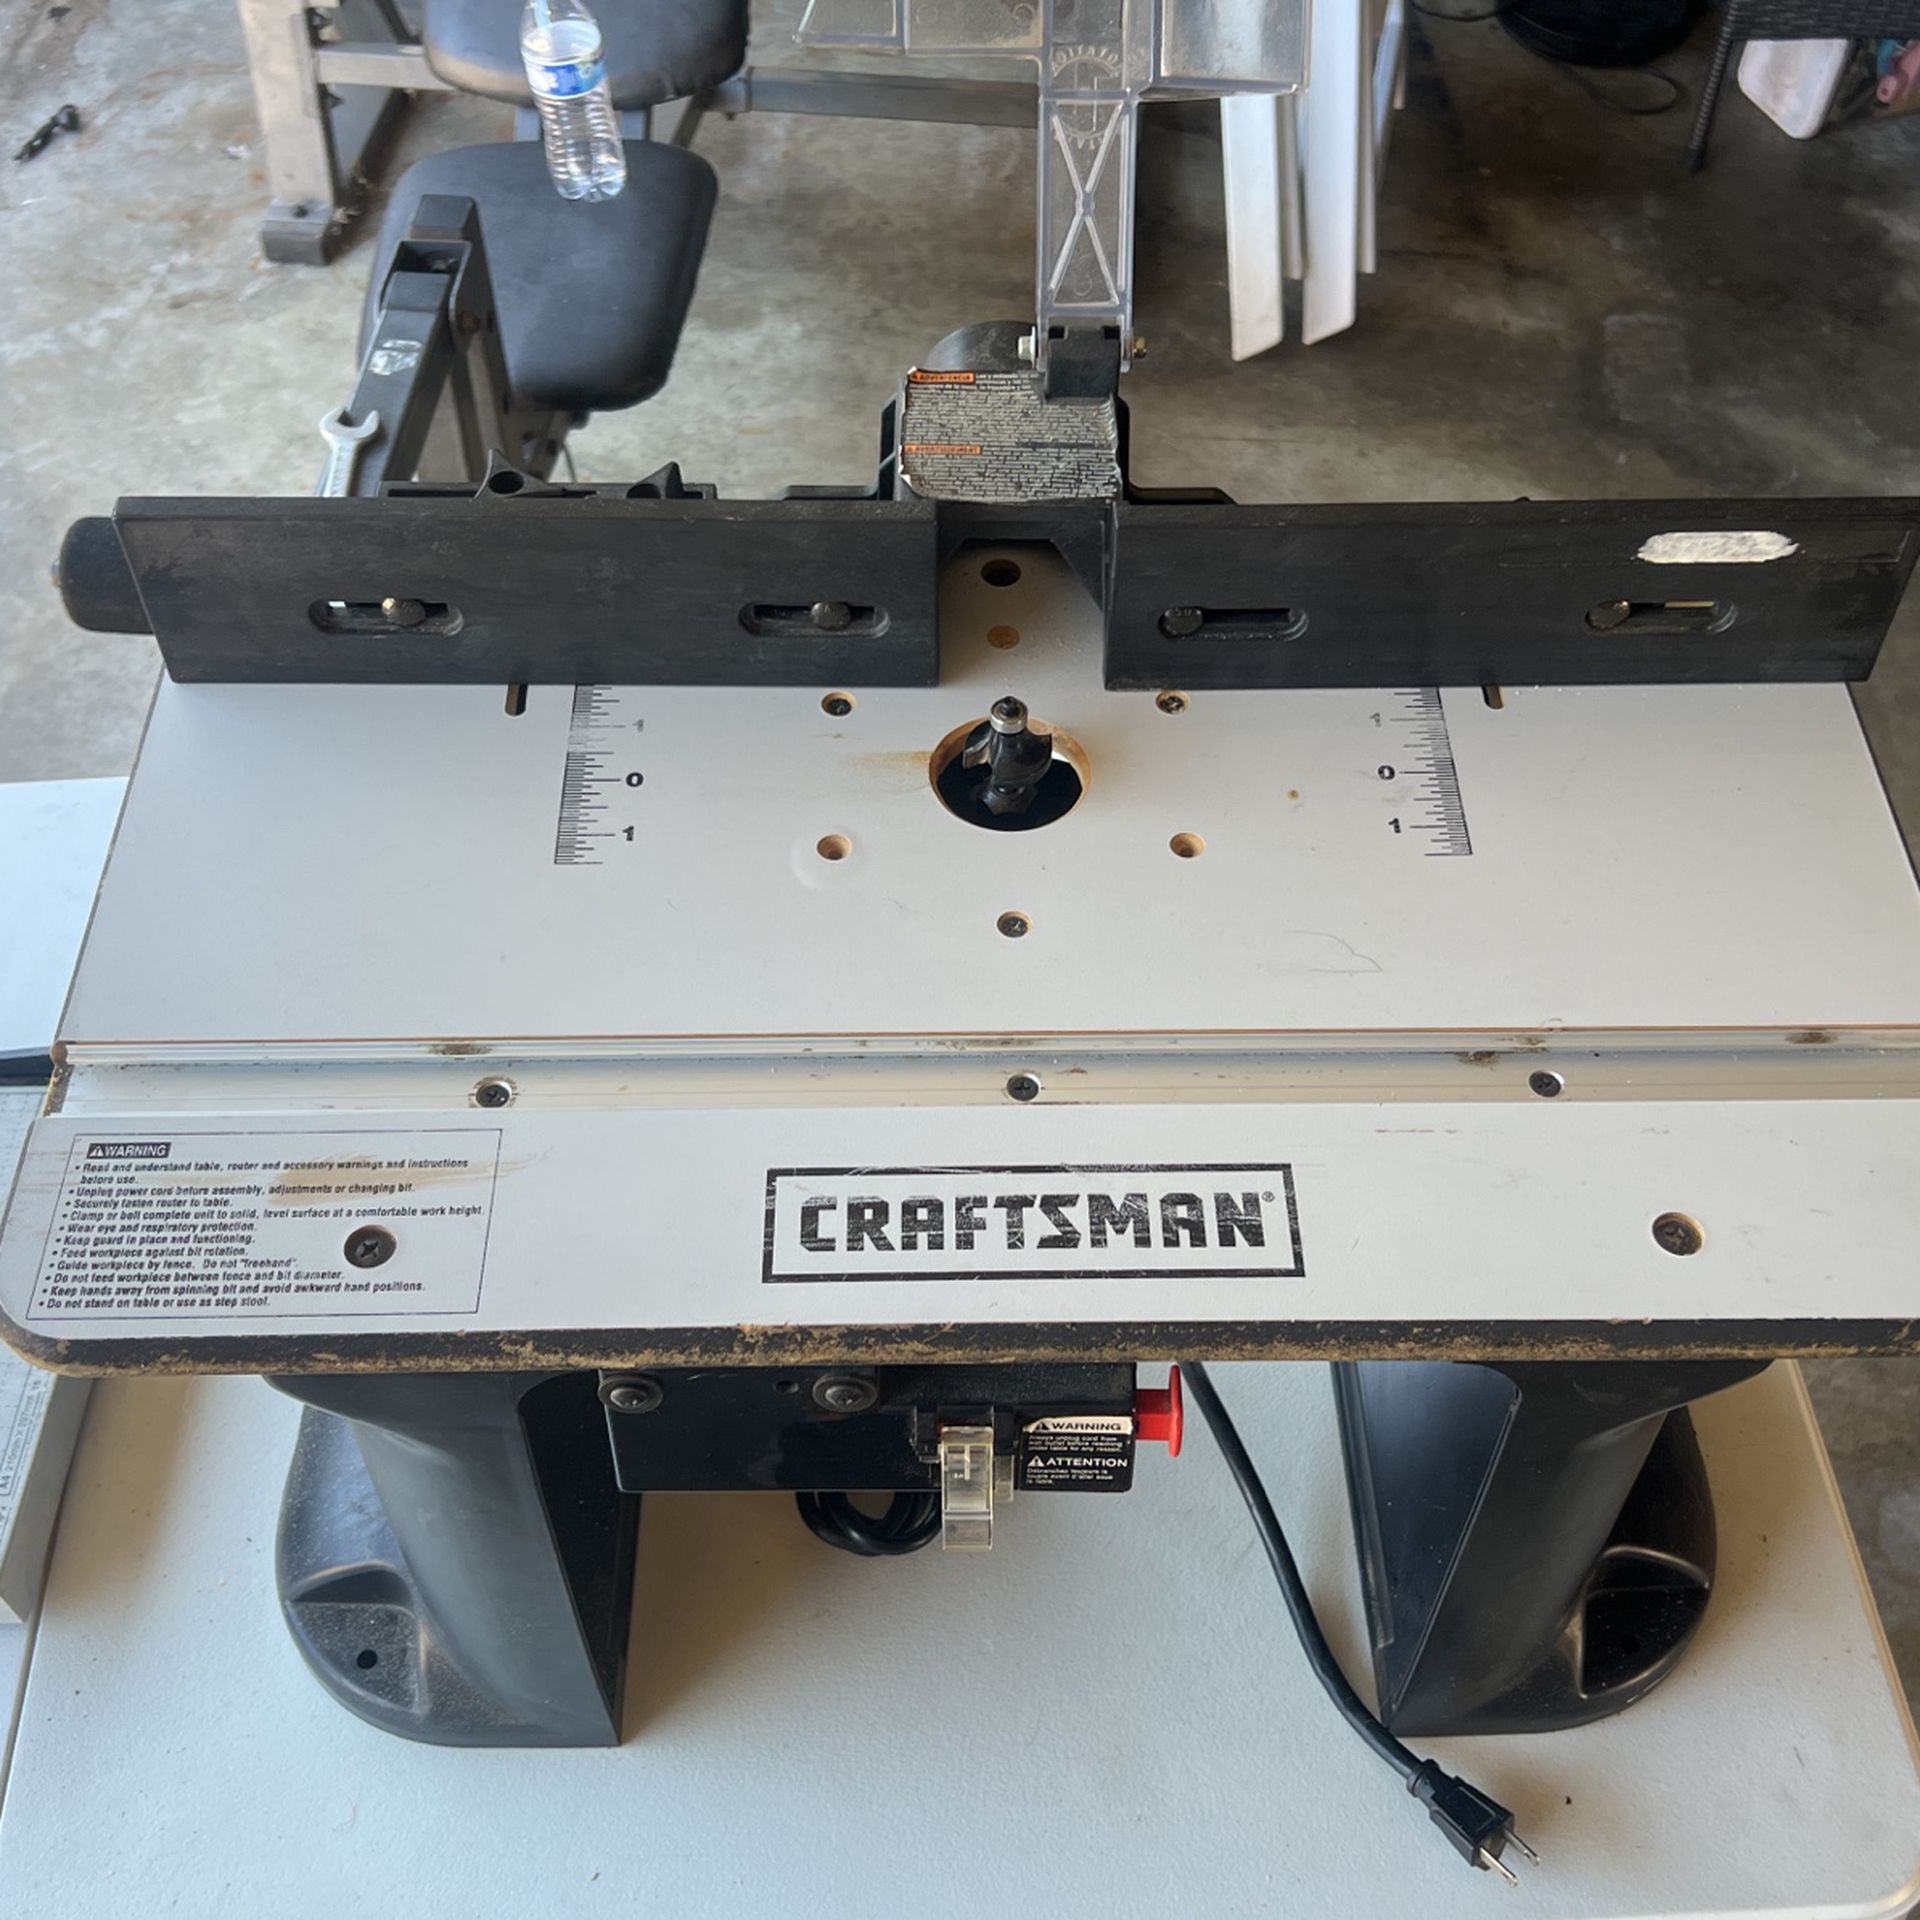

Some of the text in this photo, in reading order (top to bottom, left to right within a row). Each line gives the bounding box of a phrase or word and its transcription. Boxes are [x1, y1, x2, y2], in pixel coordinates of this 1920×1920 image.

[625, 772, 645, 788] 0
[1377, 765, 1396, 781] 0
[622, 825, 635, 842] 1
[1388, 818, 1402, 834] 1
[105, 1144, 167, 1157] WARNING
[1051, 1422, 1122, 1431] WARNING
[1046, 1457, 1128, 1468] ATTENTION
